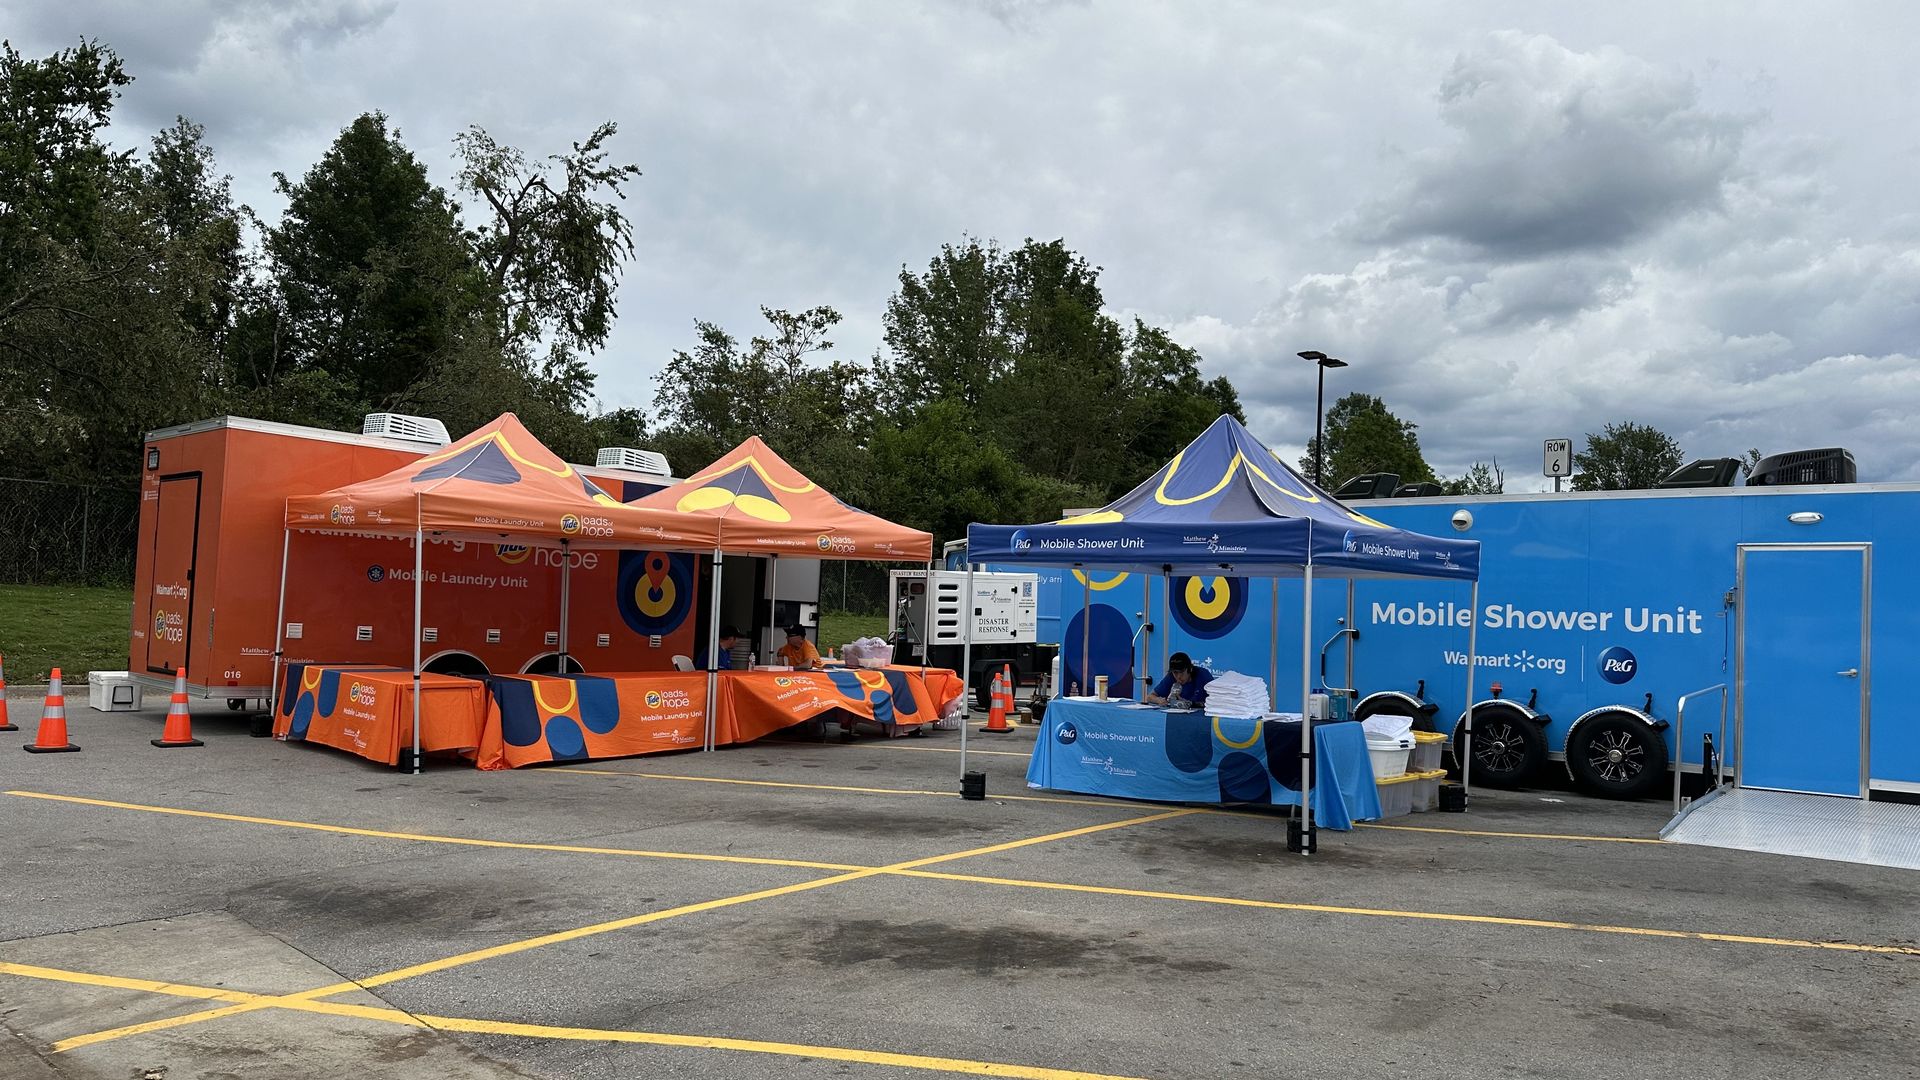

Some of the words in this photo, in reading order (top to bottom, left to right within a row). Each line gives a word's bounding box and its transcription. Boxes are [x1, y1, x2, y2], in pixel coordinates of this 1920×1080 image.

[1547, 442, 1566, 452] ROW
[1552, 459, 1560, 472] 6
[474, 516, 499, 524] Mobile
[500, 518, 529, 527] Laundry
[580, 515, 608, 526] loads
[580, 525, 614, 537] hope
[831, 535, 851, 545] loads
[1015, 538, 1031, 549] P&G
[1040, 538, 1075, 549] Mobile
[1077, 538, 1118, 549] Shower
[1120, 537, 1145, 549] Unit
[831, 544, 856, 554] hope
[1362, 543, 1384, 556] Mobile
[1384, 545, 1406, 558] Shower
[1407, 548, 1420, 560] Unit
[442, 572, 497, 588] Laundry
[501, 576, 529, 588] Unit
[1372, 602, 1472, 627] Mobile
[1484, 604, 1613, 631] Shower
[1624, 606, 1703, 634] Unit
[1443, 651, 1511, 668] Wamart
[1604, 658, 1634, 672] P&G
[224, 670, 241, 679] 016
[660, 690, 683, 699] loads
[777, 689, 799, 701] Mobile
[661, 697, 690, 709] hope
[641, 714, 663, 722] Mobile
[664, 712, 689, 720] Laundry
[1059, 729, 1076, 738] P&G
[1084, 731, 1108, 740] Mobile
[1109, 732, 1137, 742] Shower
[1138, 735, 1155, 743] Unit
